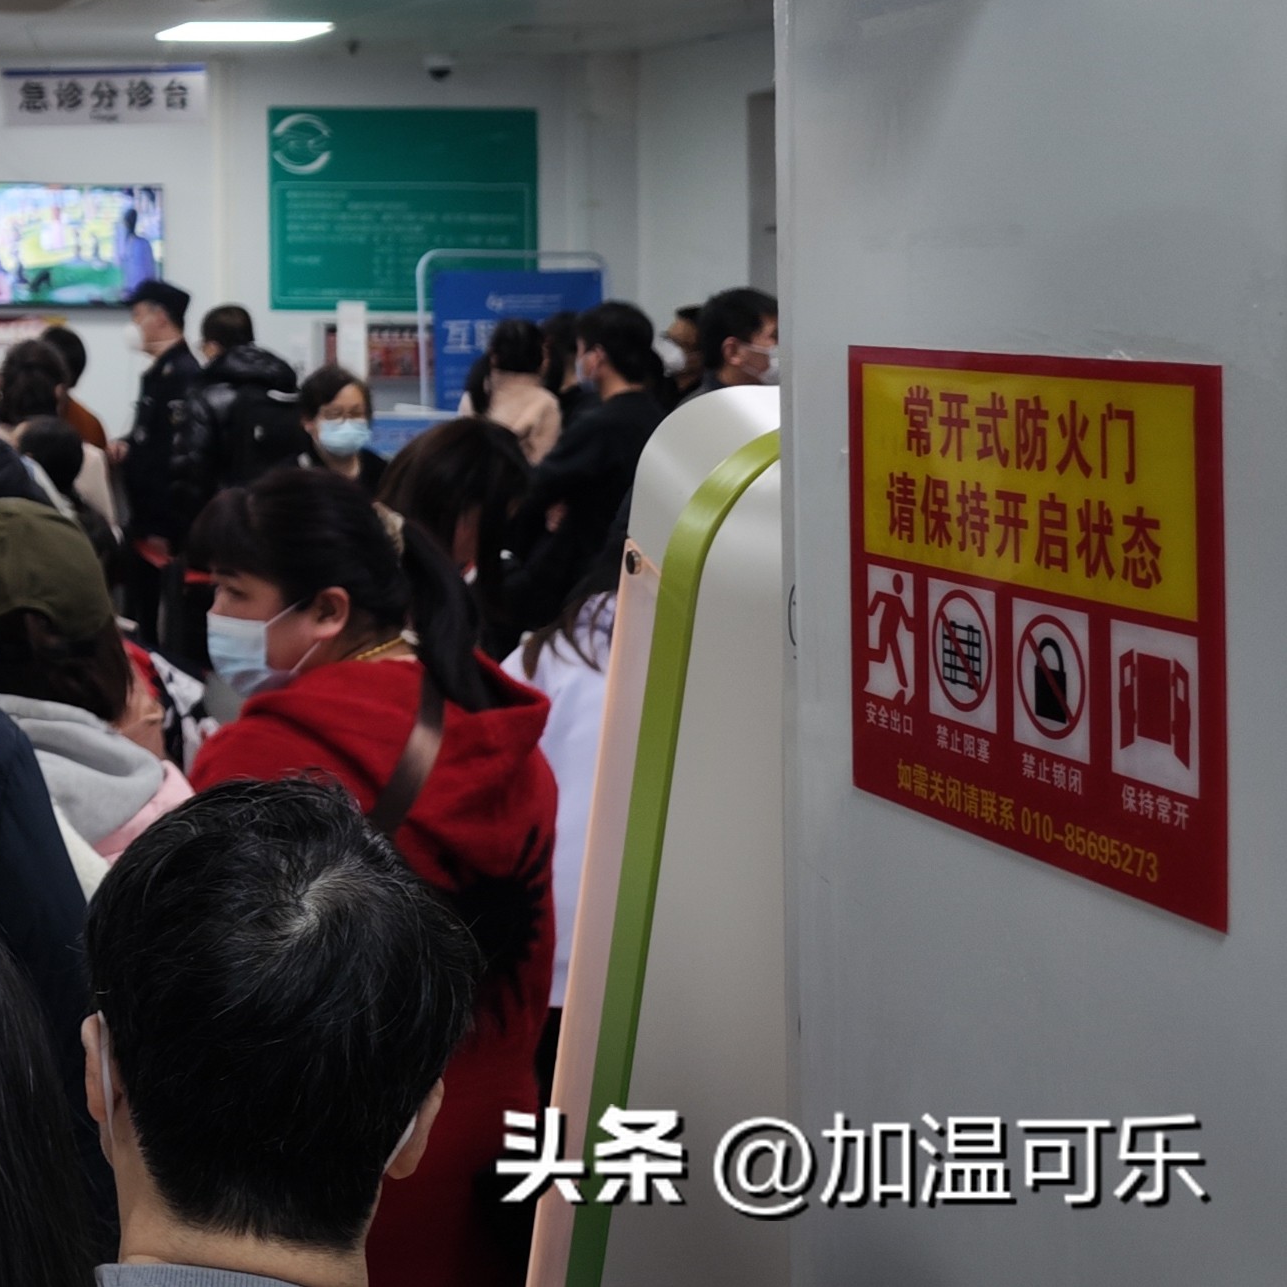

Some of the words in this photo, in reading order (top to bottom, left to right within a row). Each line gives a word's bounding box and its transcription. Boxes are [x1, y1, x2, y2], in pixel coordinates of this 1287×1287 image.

[18, 78, 188, 114] 急诊分诊台
[903, 384, 1137, 485] 常开式防火门
[886, 471, 1164, 591] 请保持开启状态
[866, 701, 914, 737] 安全出口
[936, 724, 991, 764] 禁止阻塞
[1021, 752, 1084, 796] 禁止锁闭
[897, 758, 1016, 833] 如需关闭请联系
[1021, 807, 1160, 884] 010-85695273
[1121, 783, 1190, 831] 保持常开
